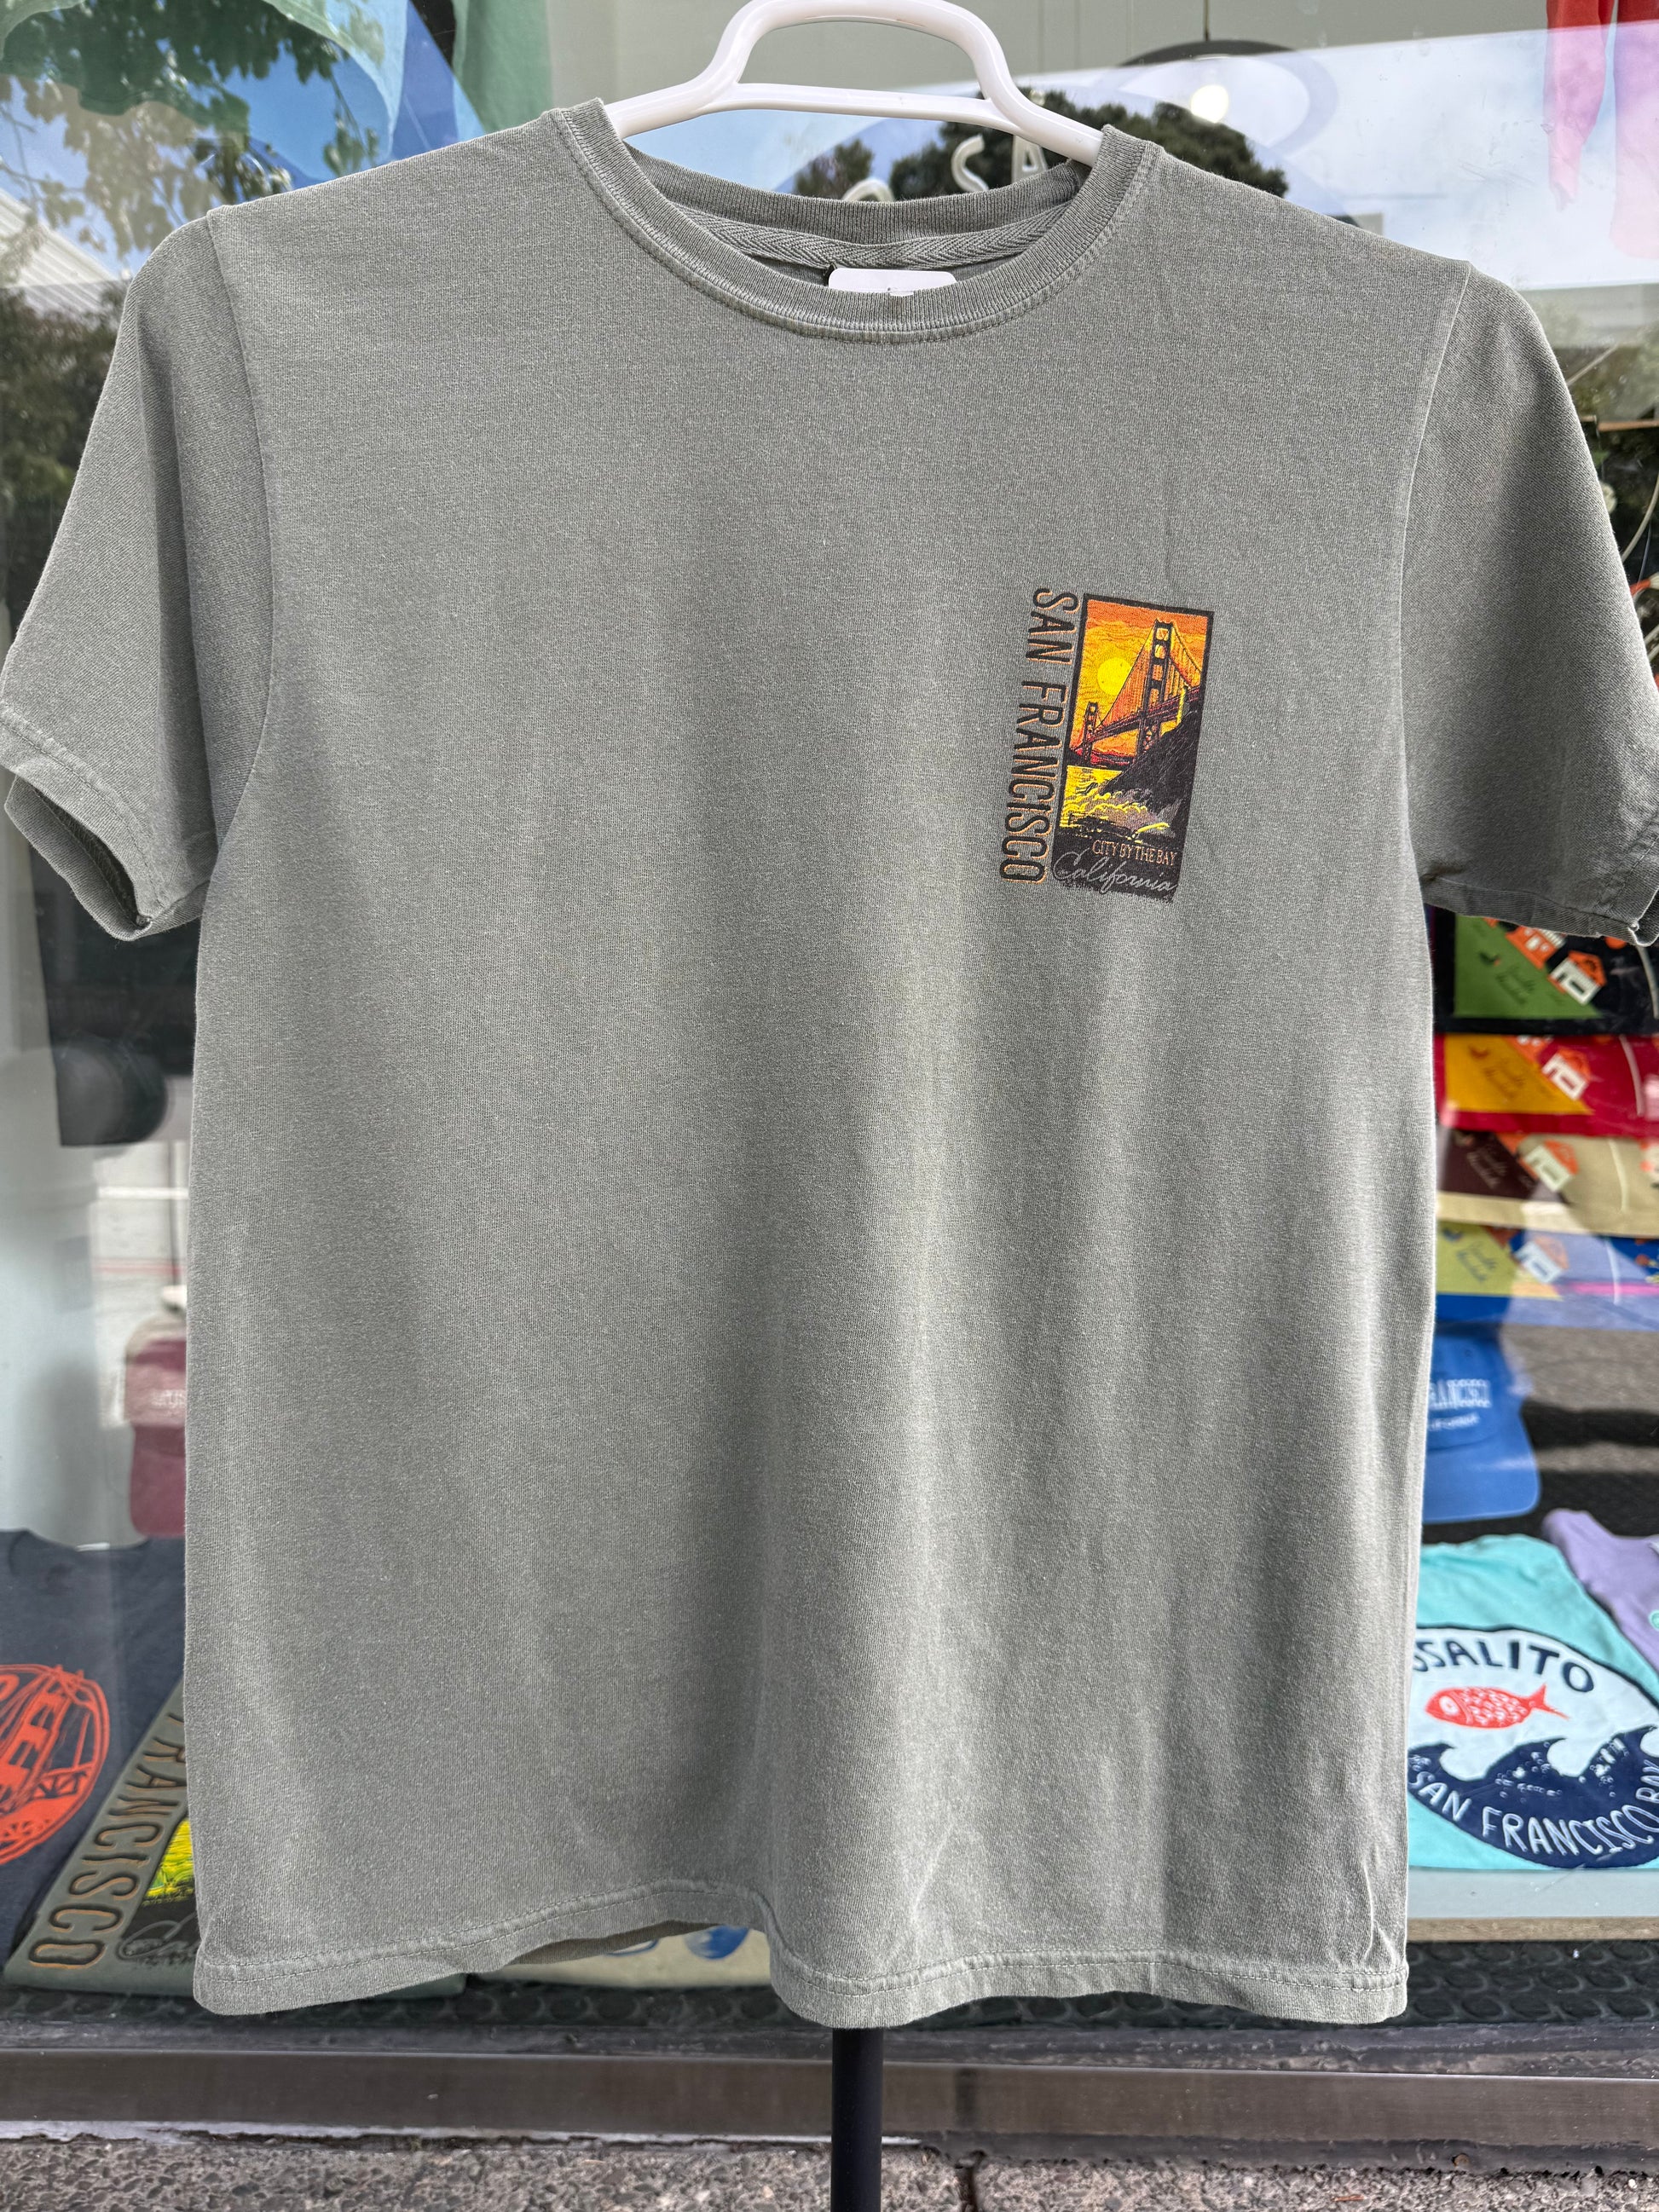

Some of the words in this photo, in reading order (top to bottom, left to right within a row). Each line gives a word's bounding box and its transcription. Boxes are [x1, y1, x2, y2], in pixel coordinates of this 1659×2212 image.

[1026, 587, 1080, 665] SAN
[1000, 680, 1069, 885] FRANCISCO
[1053, 846, 1179, 894] California
[1092, 840, 1119, 858] CITY
[1119, 843, 1135, 859] BY
[1135, 846, 1156, 863] THE
[1156, 849, 1177, 866] BAY
[28, 1712, 187, 1970] RANCISCO
[1482, 1803, 1659, 1856] FRANCISCO
